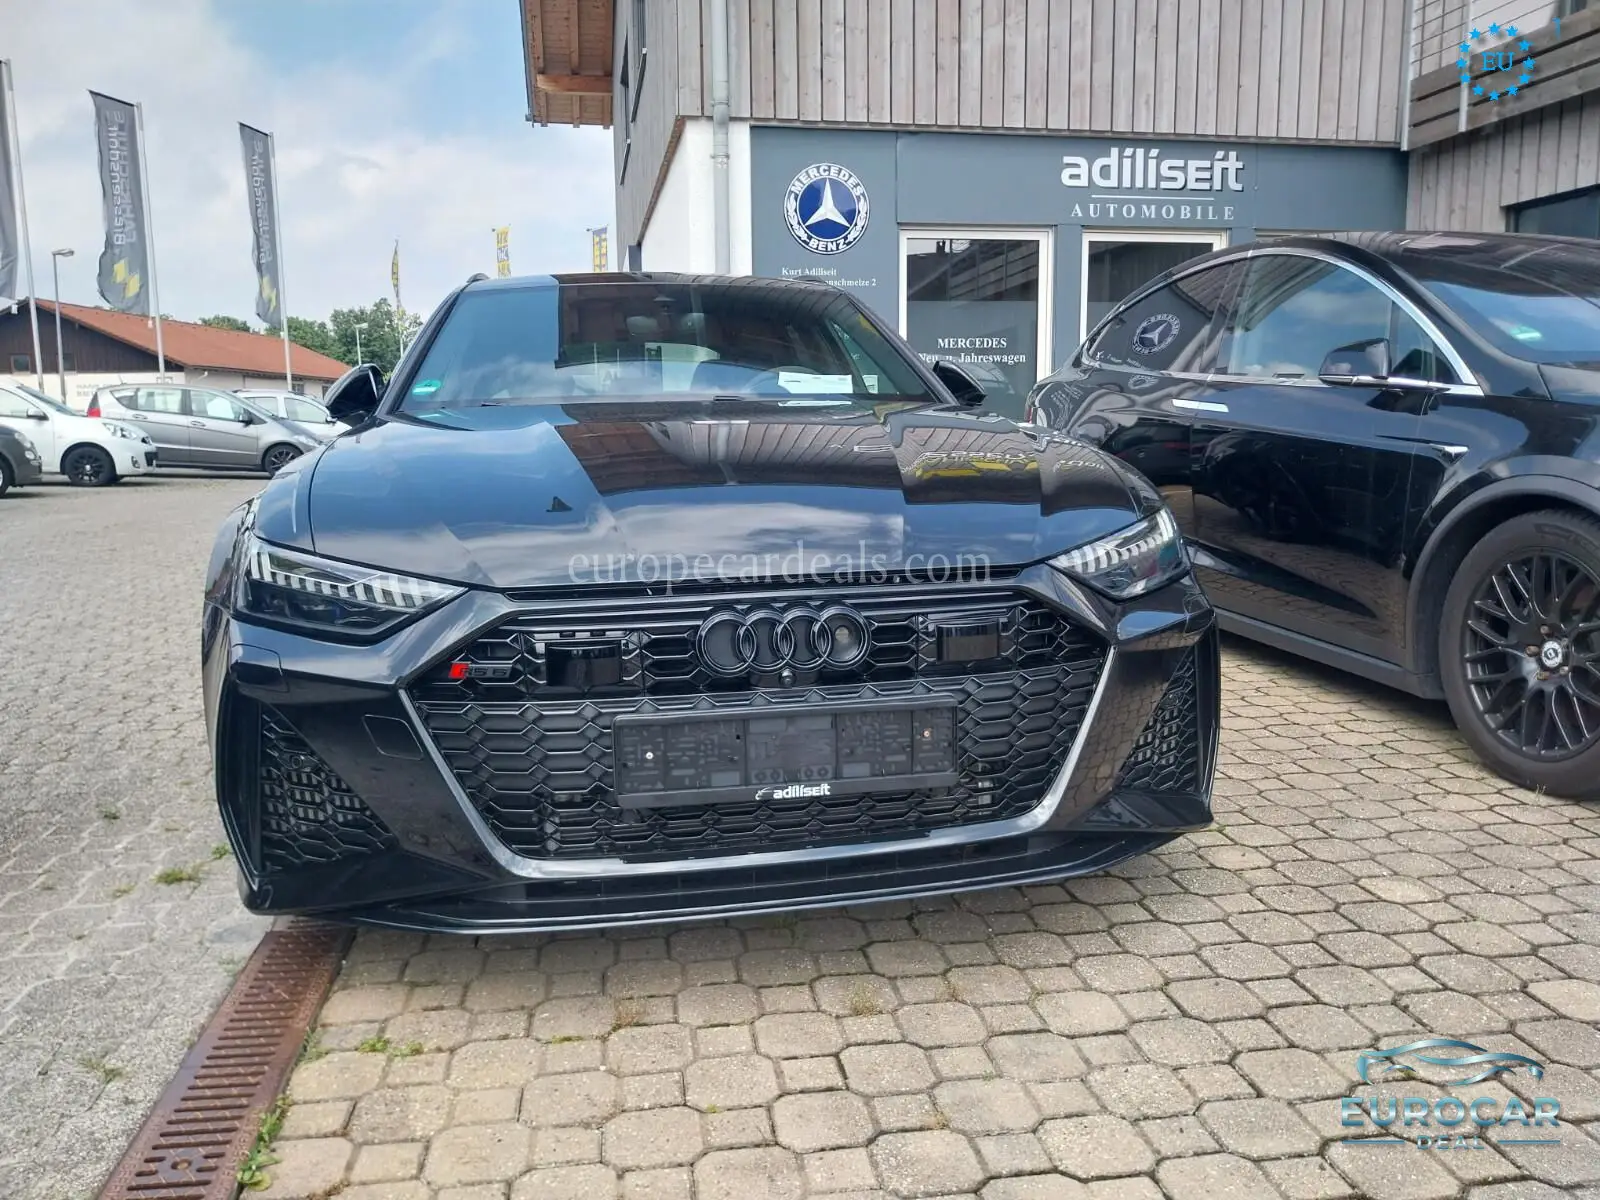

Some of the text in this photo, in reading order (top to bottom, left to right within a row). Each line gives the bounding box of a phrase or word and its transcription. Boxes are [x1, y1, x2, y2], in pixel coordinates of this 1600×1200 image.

[791, 165, 865, 197] MERCEDES
[1071, 203, 1235, 221] AUTOMOBILE
[808, 238, 848, 252] BENZ
[782, 267, 802, 276] Kurt
[871, 278, 877, 287] 2
[937, 337, 1007, 349] MERCEDES
[959, 352, 1026, 366] Jahreswagen
